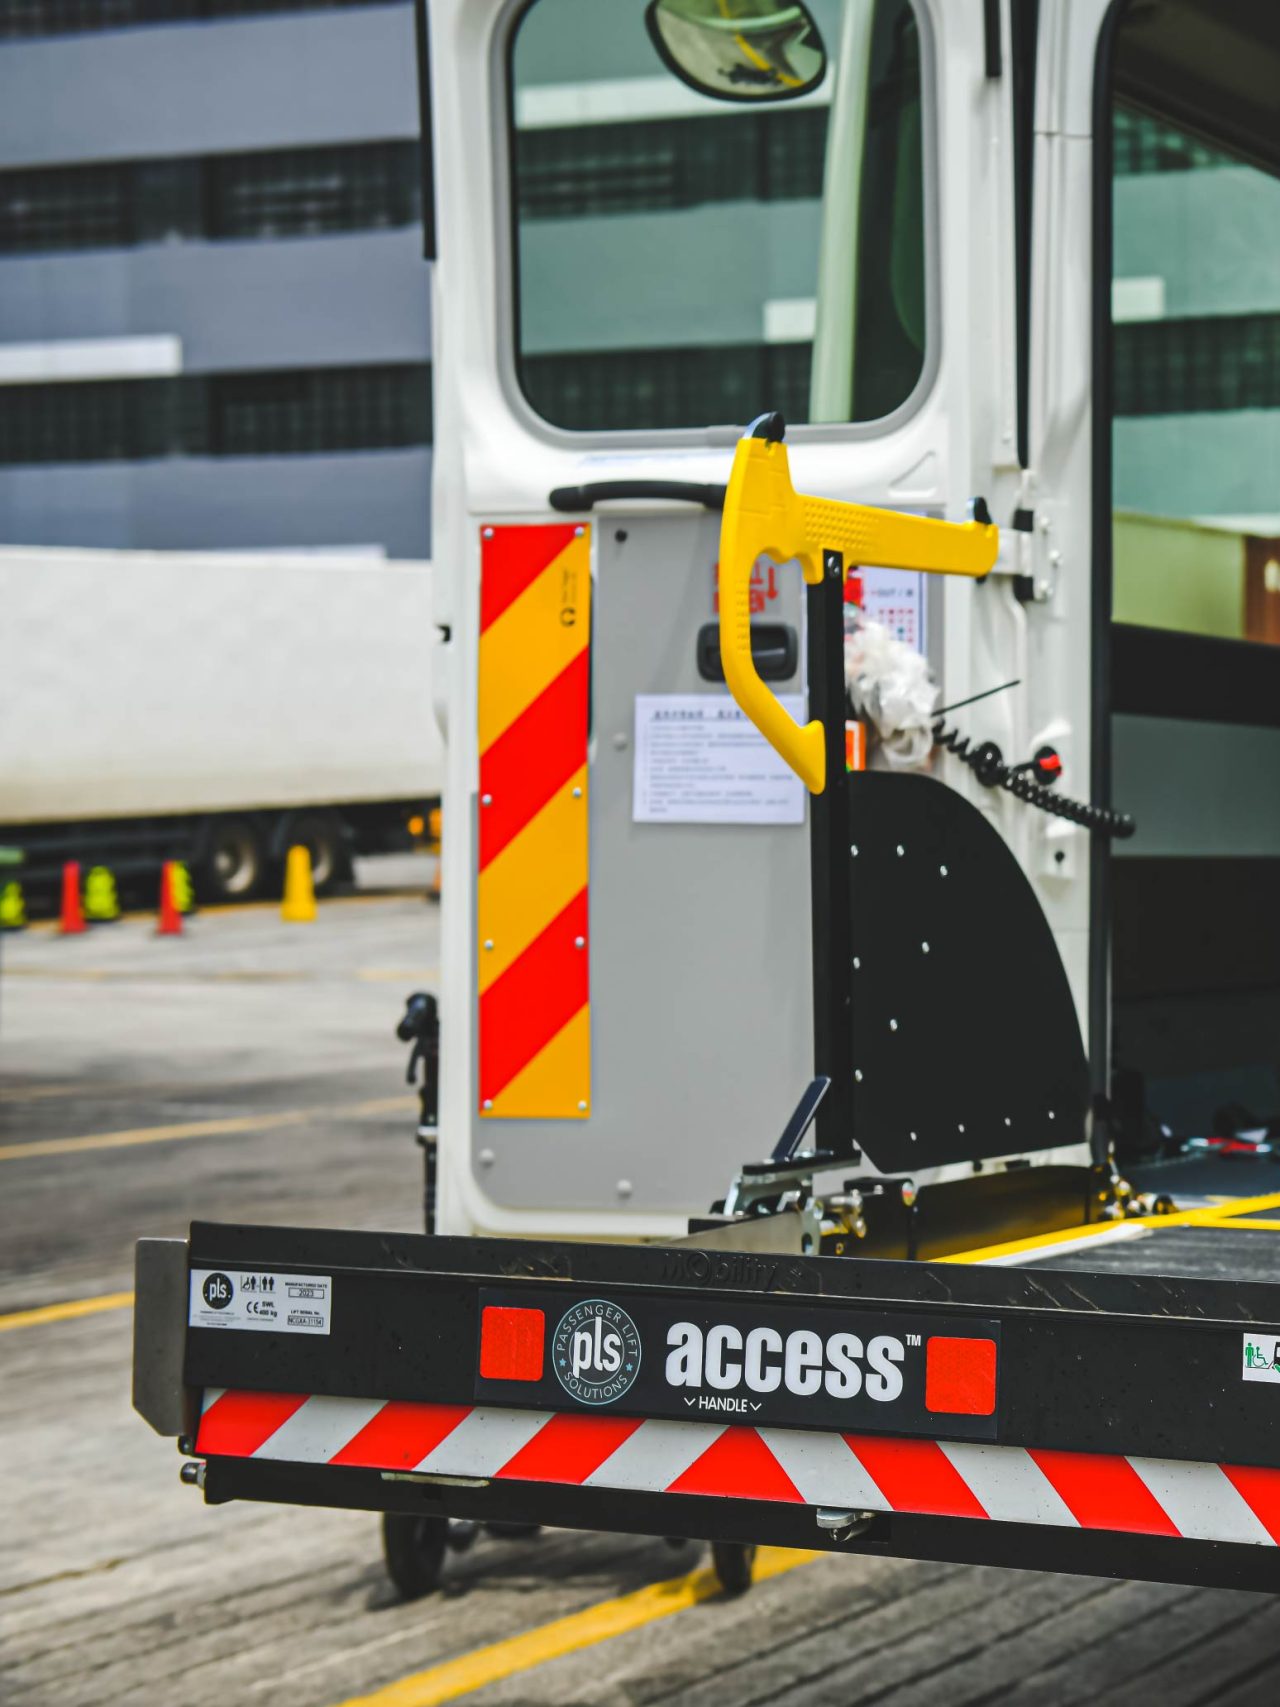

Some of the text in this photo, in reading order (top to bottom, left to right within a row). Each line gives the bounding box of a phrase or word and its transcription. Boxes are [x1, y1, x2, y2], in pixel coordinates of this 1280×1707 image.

[209, 1277, 227, 1301] pls
[557, 1305, 638, 1357] PASSENGER LIFT
[572, 1316, 621, 1379] pls
[665, 1321, 905, 1402] access
[564, 1371, 628, 1399] SOLUTIONS
[698, 1396, 748, 1413] HANDLE
